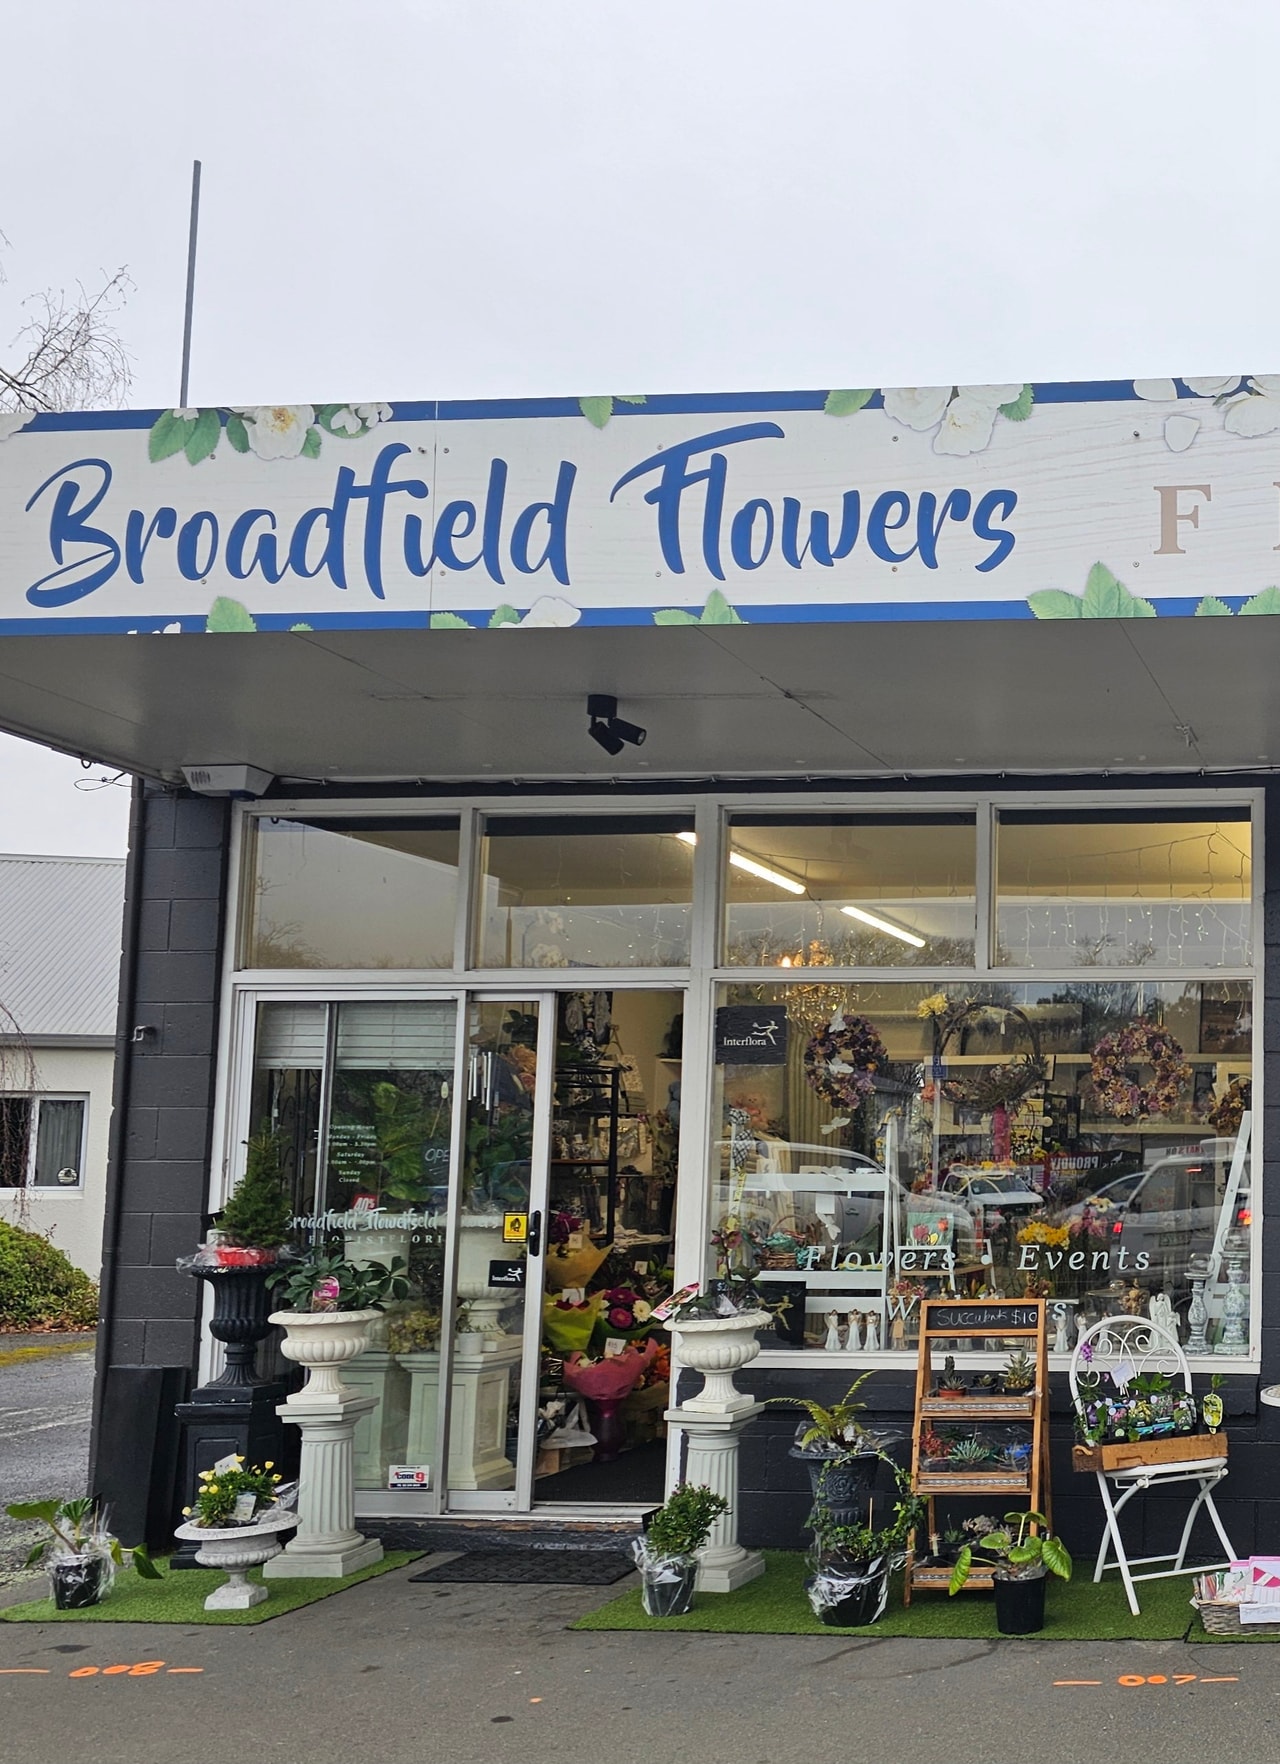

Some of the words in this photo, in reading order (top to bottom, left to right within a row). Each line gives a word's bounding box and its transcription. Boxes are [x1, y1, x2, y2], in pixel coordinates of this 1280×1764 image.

[26, 442, 577, 608] Broadfield
[611, 422, 1018, 581] Flowers
[723, 1036, 767, 1046] Interflora
[424, 1148, 451, 1164] OPE
[803, 1244, 957, 1271] Flowers
[1016, 1244, 1151, 1271] Events
